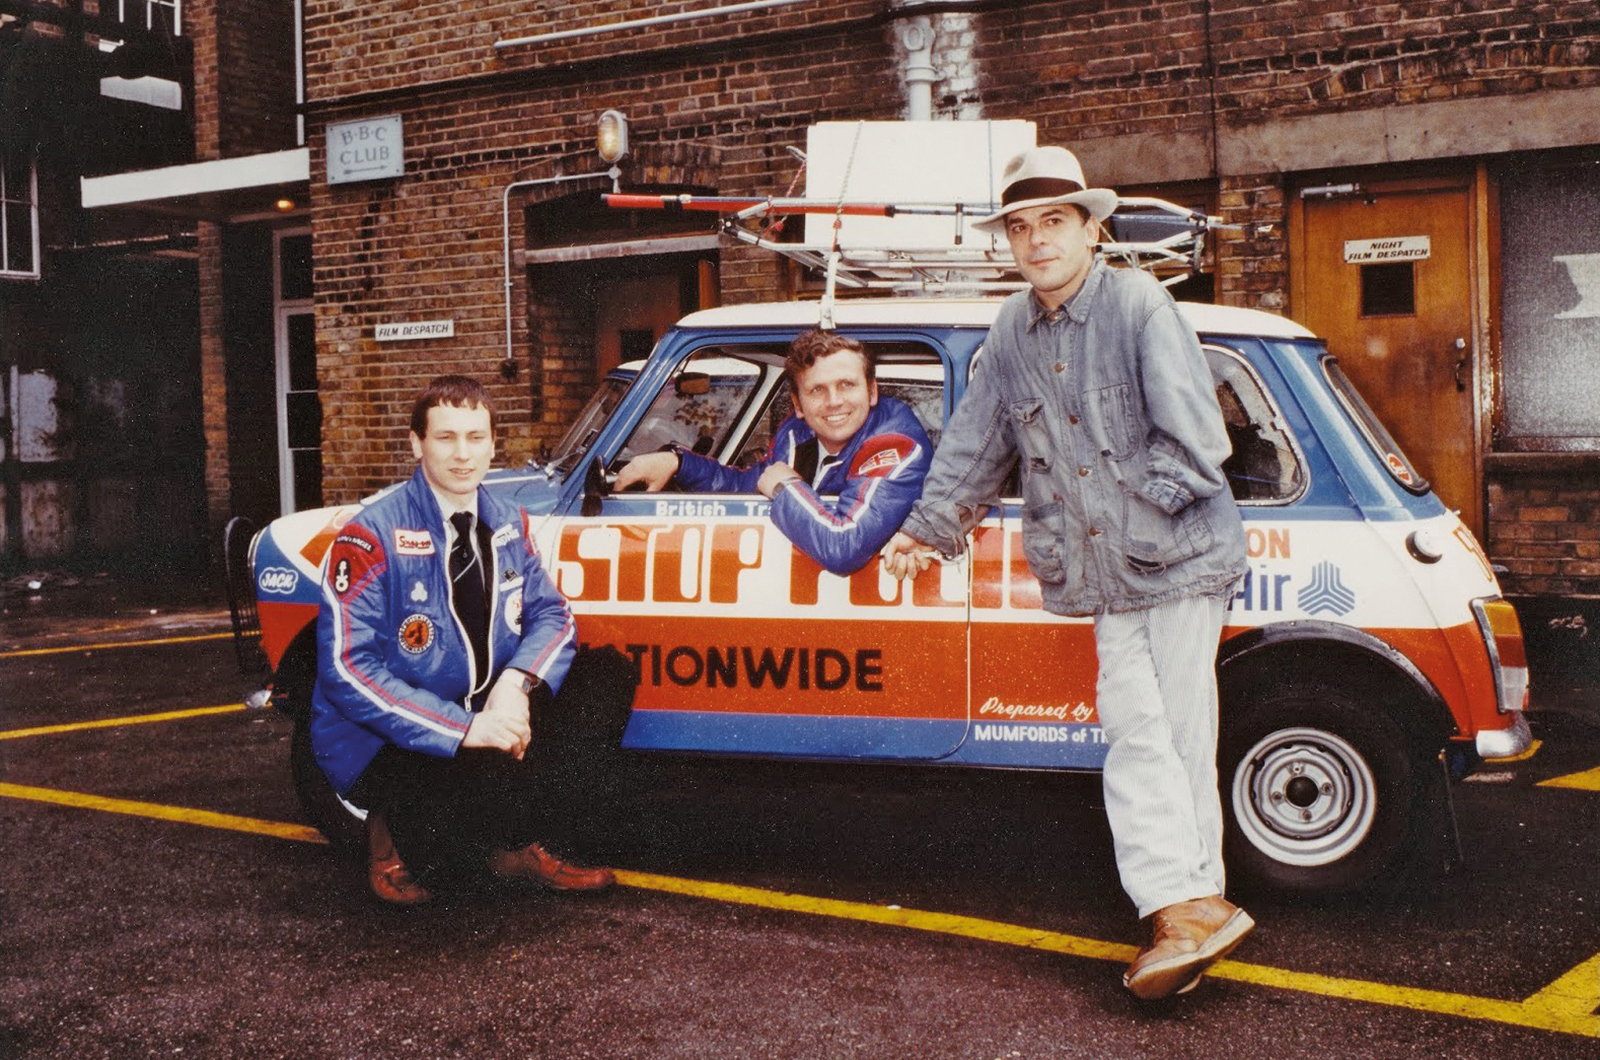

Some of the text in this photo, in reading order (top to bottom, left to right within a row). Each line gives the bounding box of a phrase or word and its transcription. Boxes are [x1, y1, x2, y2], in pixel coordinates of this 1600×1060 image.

[340, 146, 390, 165] CLUB
[1348, 248, 1428, 260] FILM DESPATCH
[1369, 241, 1404, 249] NIGHT
[379, 323, 450, 337] FILM DESPATCH
[656, 501, 771, 517] British Tr
[557, 523, 765, 603] STOP
[262, 573, 294, 588] JACK
[1227, 564, 1292, 611] Air
[580, 643, 883, 692] TIONWIDE
[979, 696, 1093, 722] Prepared by
[974, 725, 1068, 742] MUMFORDS
[1071, 729, 1088, 743] of
